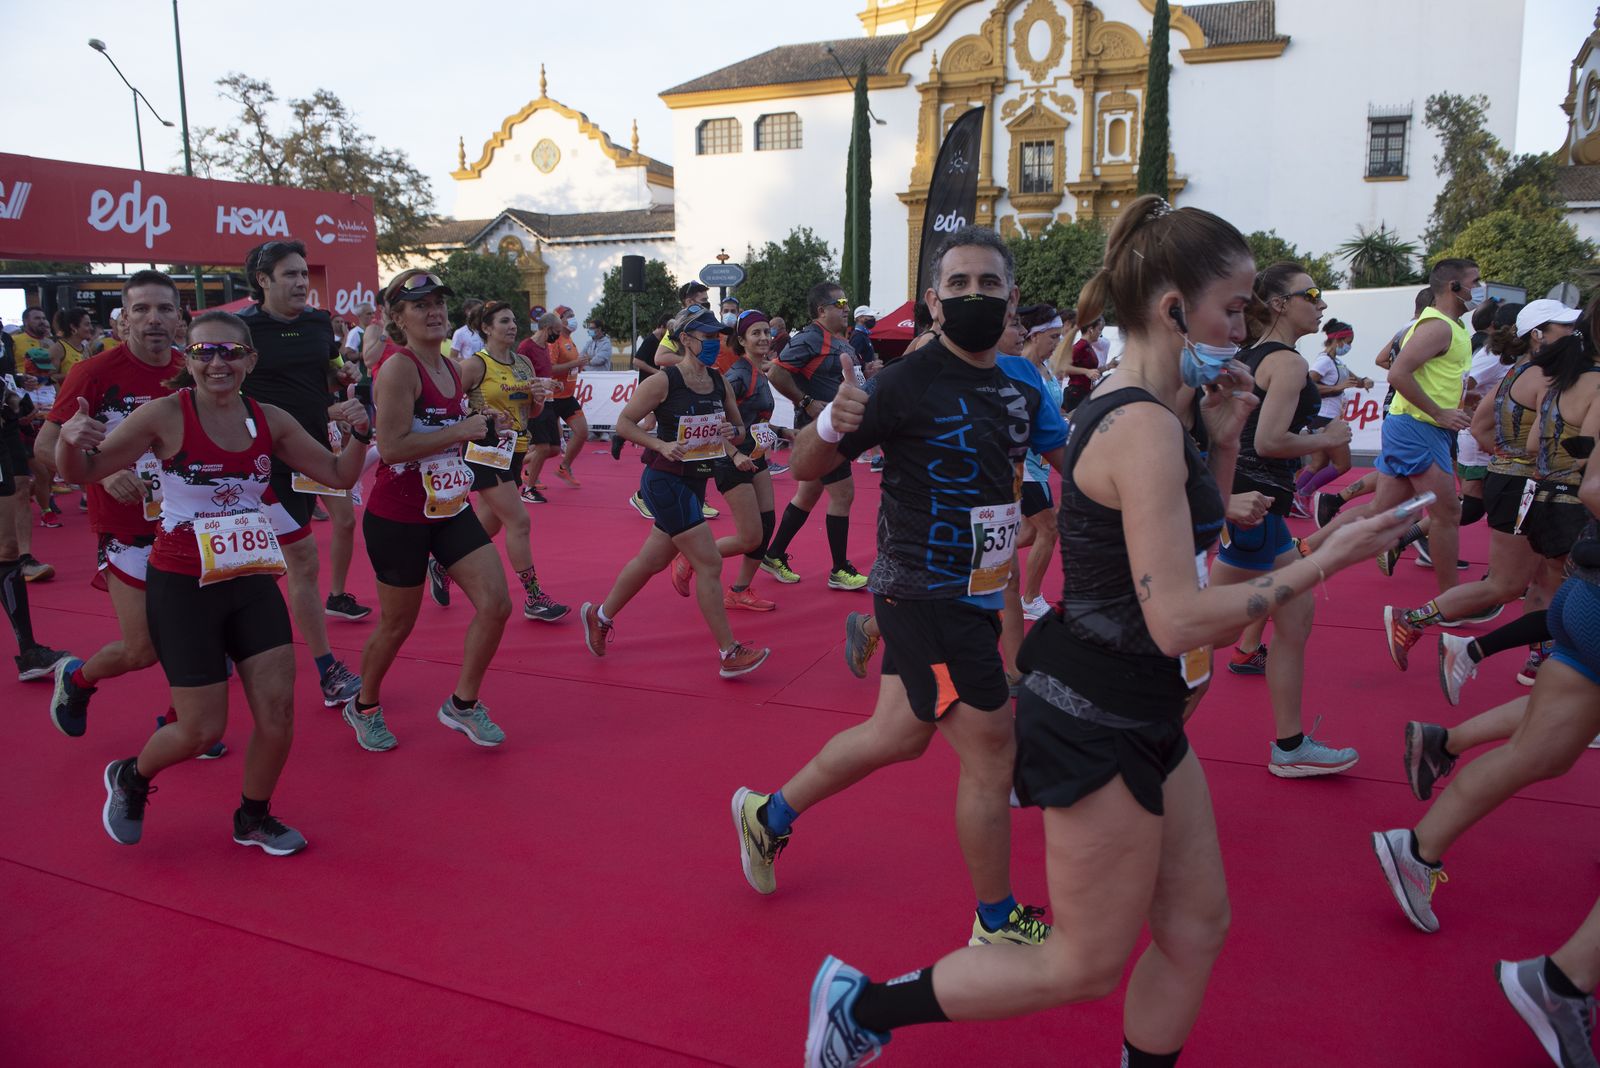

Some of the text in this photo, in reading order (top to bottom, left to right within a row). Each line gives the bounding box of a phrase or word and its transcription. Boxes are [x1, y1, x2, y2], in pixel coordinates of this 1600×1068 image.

[87, 179, 171, 249] edp
[216, 205, 290, 237] HOKA
[1343, 392, 1380, 430] dp
[683, 424, 718, 440] 6465
[209, 529, 269, 555] 6189
